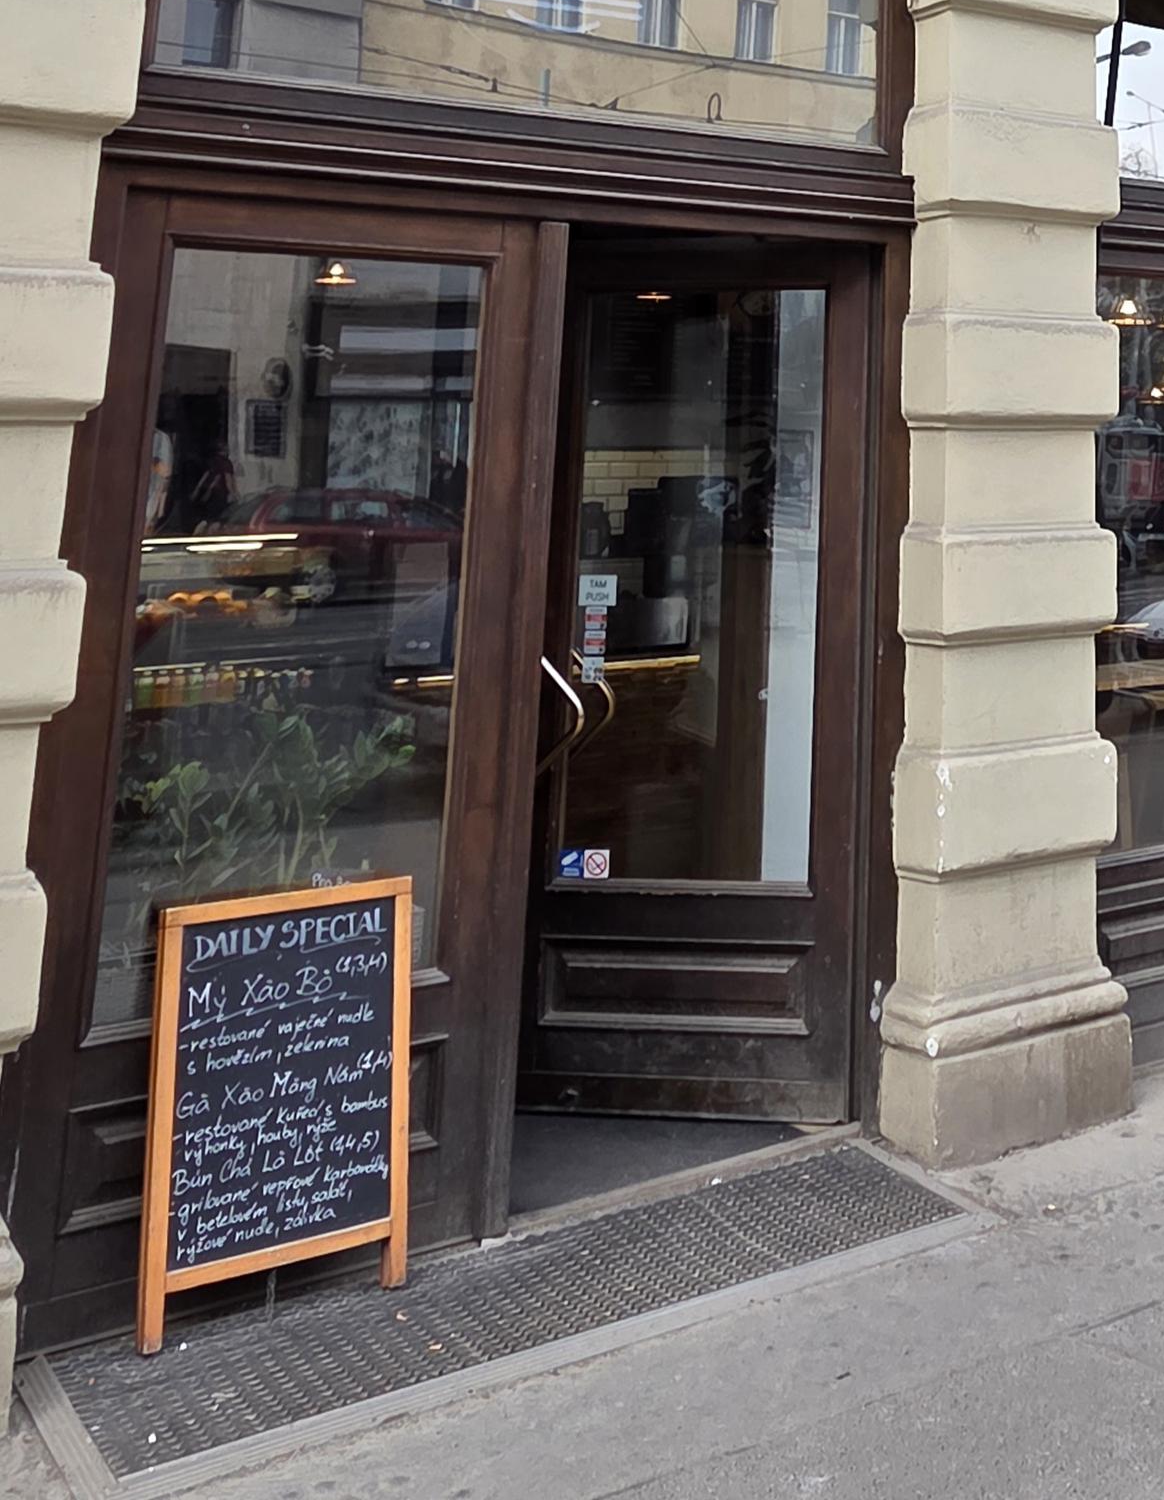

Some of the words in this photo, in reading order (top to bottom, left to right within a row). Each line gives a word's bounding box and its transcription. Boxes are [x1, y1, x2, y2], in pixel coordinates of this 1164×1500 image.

[589, 579, 607, 588] TAM
[585, 592, 609, 601] PUSH
[194, 925, 275, 961] DAILY
[280, 907, 387, 949] SPECIAL
[187, 1060, 196, 1075] s
[325, 1104, 333, 1116] s
[178, 1229, 187, 1241] v
